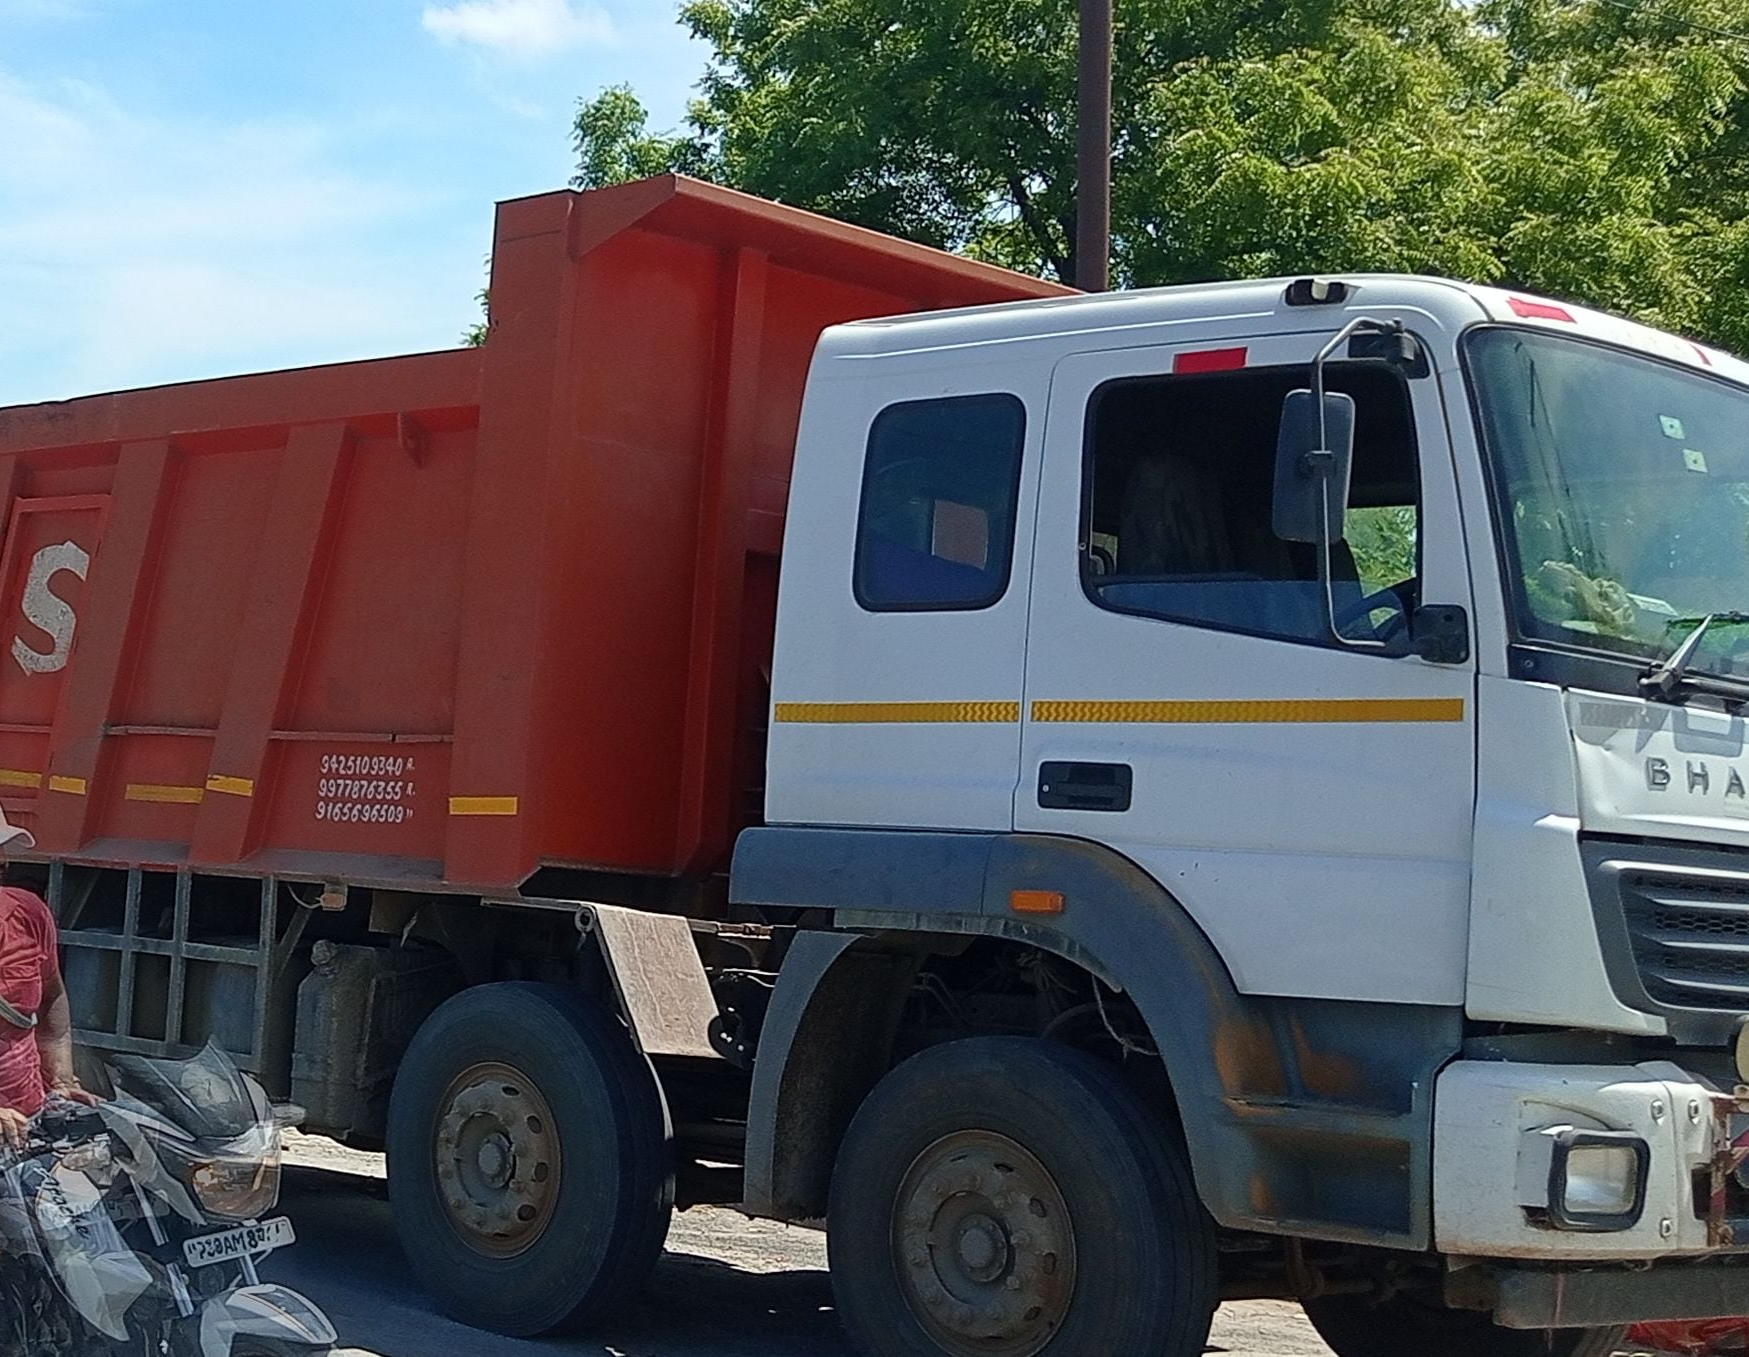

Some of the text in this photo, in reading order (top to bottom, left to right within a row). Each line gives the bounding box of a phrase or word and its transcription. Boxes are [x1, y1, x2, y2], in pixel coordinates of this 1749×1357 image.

[320, 755, 403, 777] 9425109340
[318, 778, 404, 800] 9977876355
[1644, 756, 1747, 800] BHA
[315, 801, 404, 823] 9165696509
